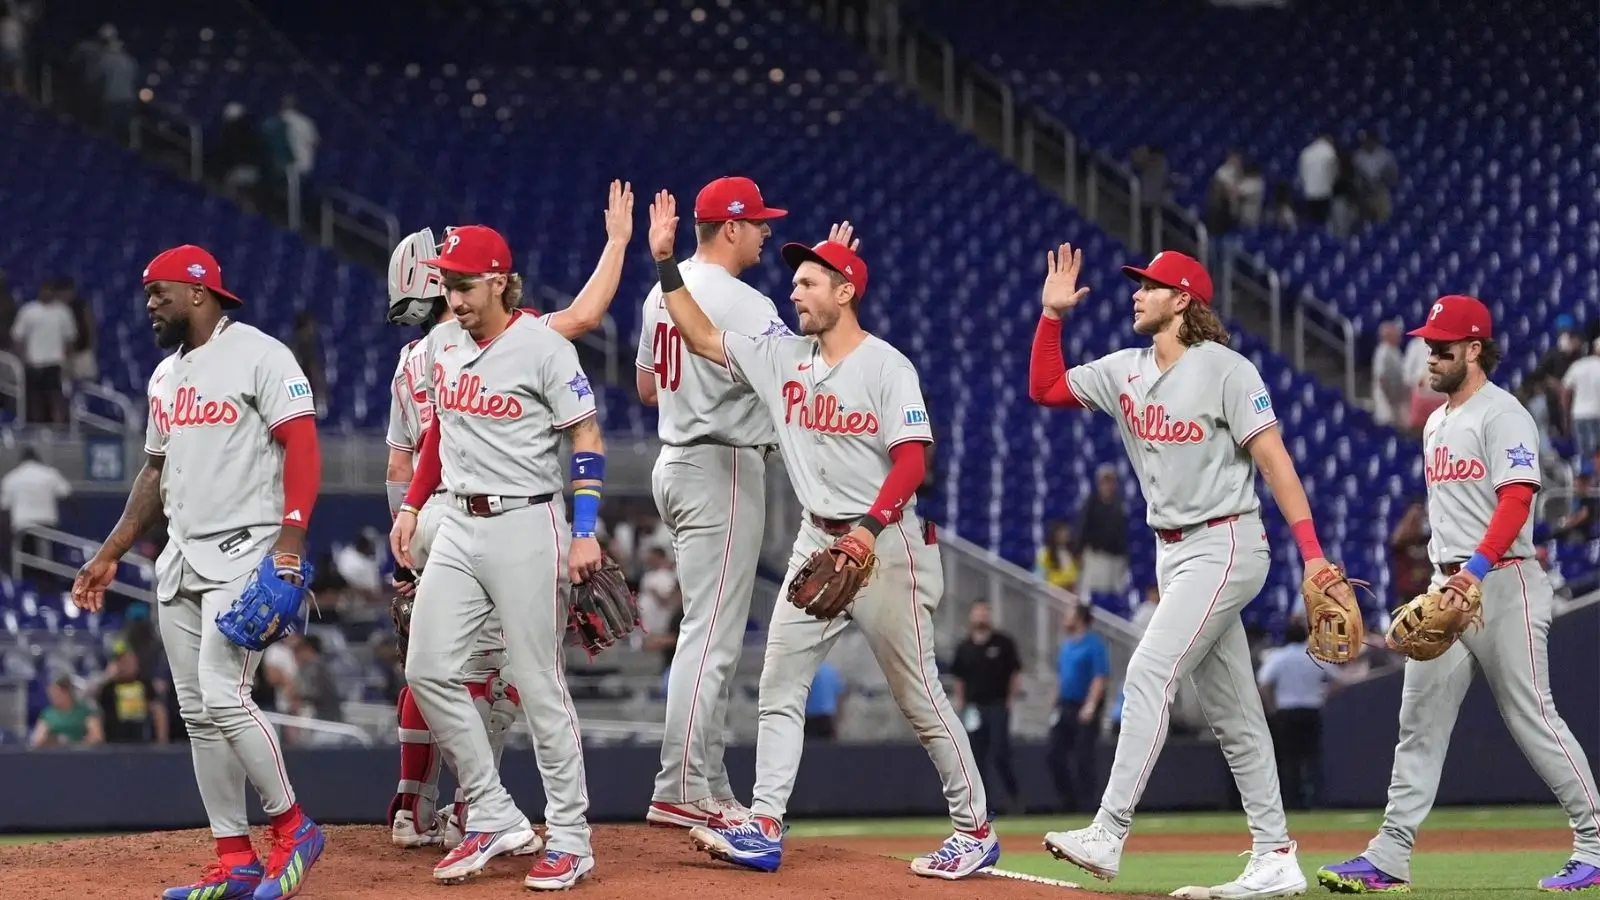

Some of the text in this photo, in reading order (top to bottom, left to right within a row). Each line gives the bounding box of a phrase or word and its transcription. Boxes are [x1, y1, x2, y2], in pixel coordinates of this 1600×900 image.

[653, 322, 682, 392] 40
[151, 386, 239, 437] Phllies
[432, 362, 523, 418] Phillies
[781, 380, 879, 435] Phllies
[579, 465, 585, 474] 5
[1426, 446, 1486, 486] hllies
